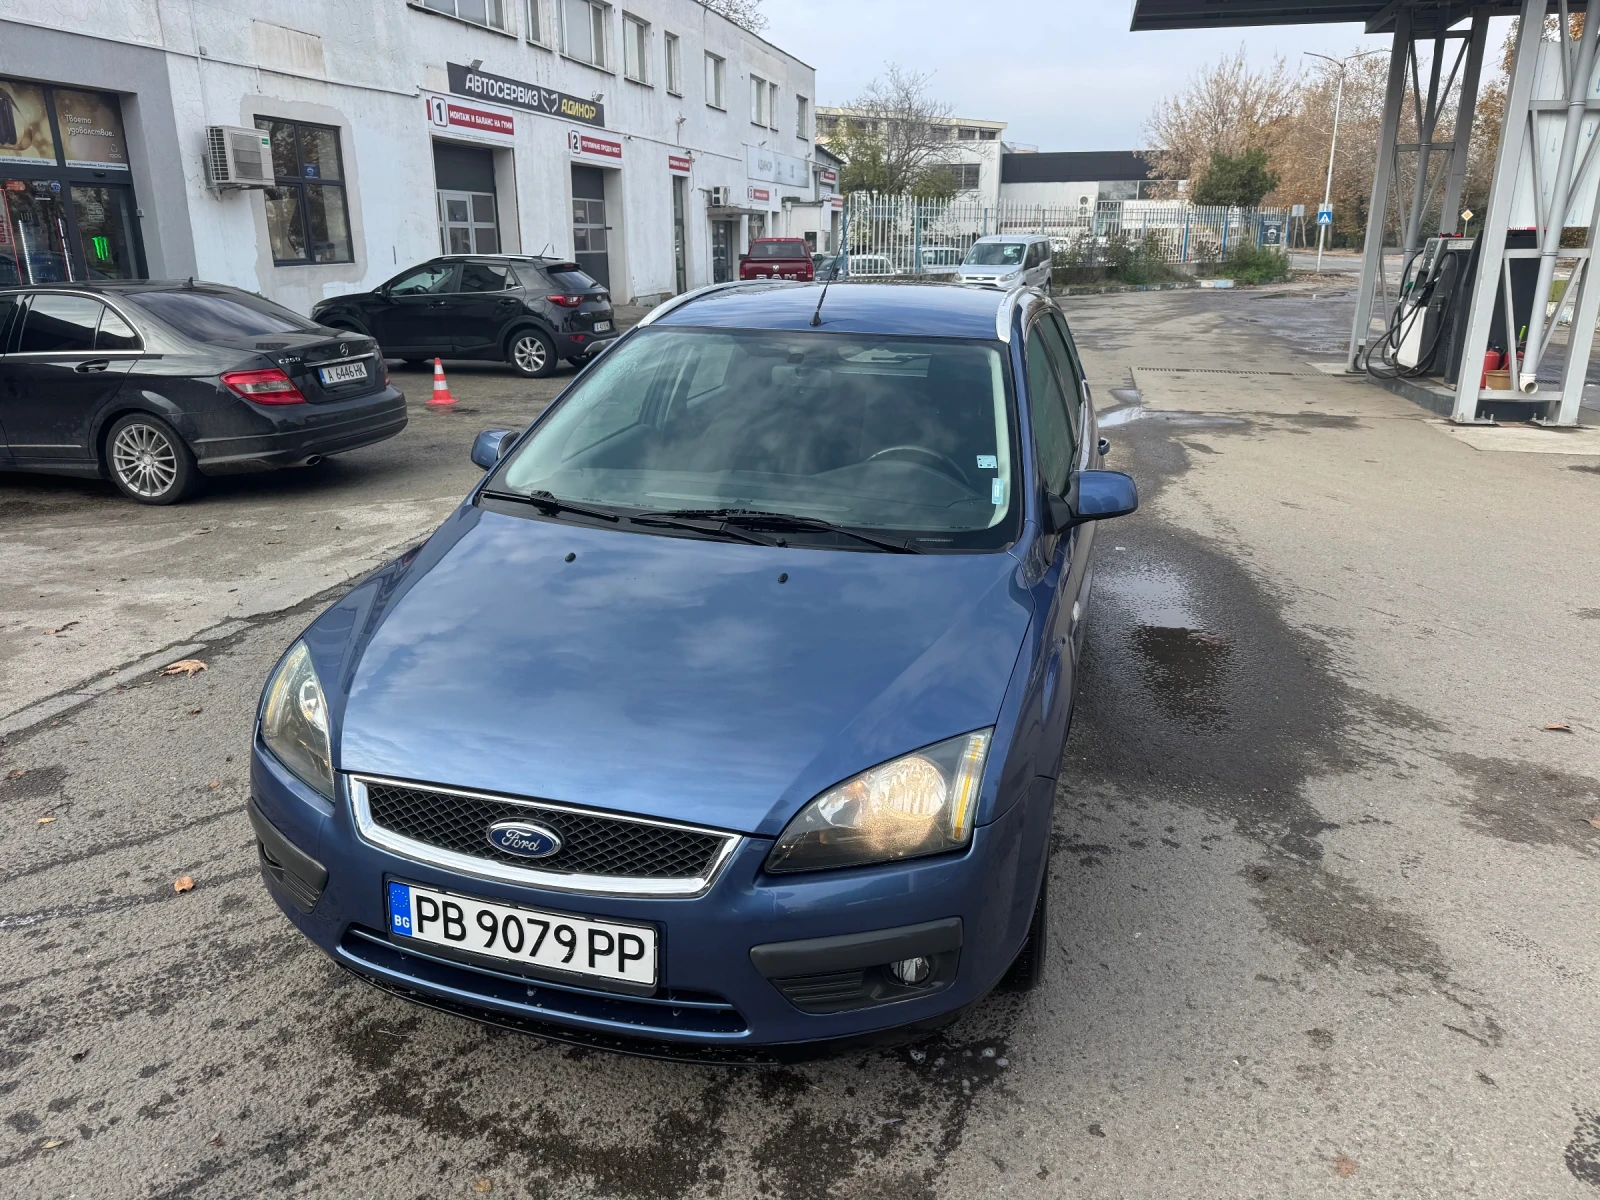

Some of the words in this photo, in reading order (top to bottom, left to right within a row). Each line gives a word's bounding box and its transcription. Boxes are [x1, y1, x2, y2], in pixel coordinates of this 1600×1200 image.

[465, 73, 538, 106] АВТОСЕРВИЗ
[560, 98, 596, 119] АДИНОР
[65, 113, 92, 125] Твоето
[436, 102, 442, 122] 1
[449, 110, 470, 122] МОНТАЖ
[475, 115, 494, 126] БАЛАНС
[501, 120, 513, 129] ГУМИ
[66, 126, 115, 137] удоволствие.
[573, 134, 579, 150] 2
[335, 366, 354, 380] 6446
[501, 828, 540, 852] Ford
[394, 914, 410, 929] BG
[415, 894, 467, 942] PB
[476, 909, 577, 964] 9079
[588, 928, 645, 973] PP
